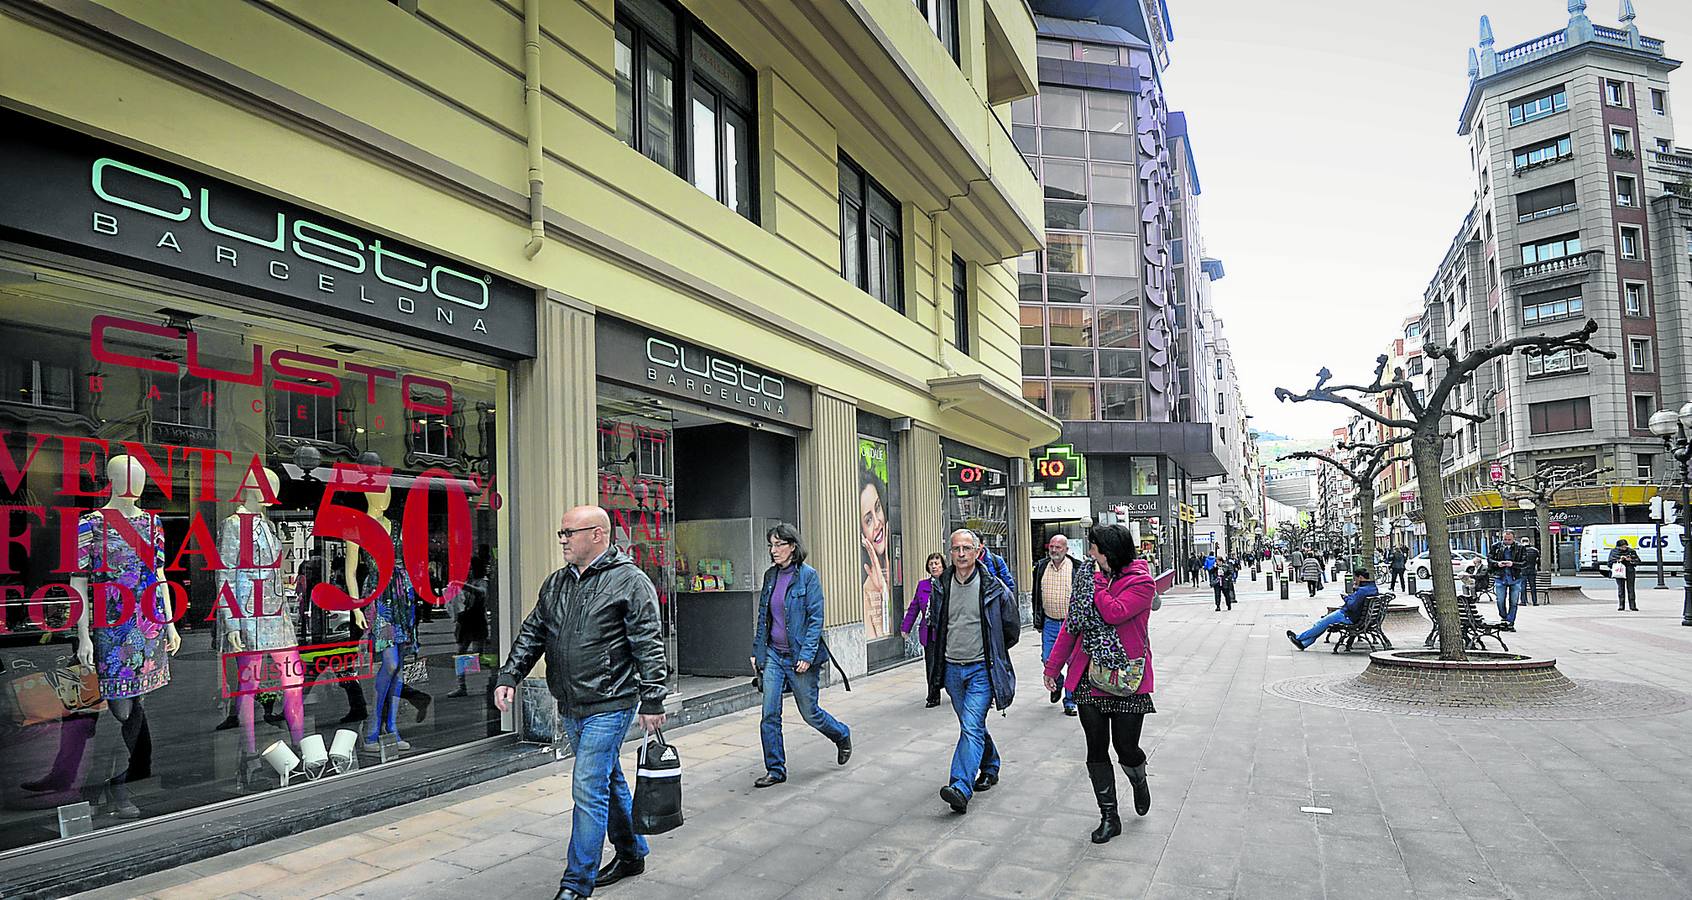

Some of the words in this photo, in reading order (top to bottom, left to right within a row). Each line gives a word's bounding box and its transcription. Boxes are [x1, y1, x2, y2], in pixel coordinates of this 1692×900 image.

[93, 211, 488, 334] BARCELONA
[91, 314, 453, 416] CUSTO
[648, 367, 784, 415] BARCELONA
[89, 375, 454, 440] BARCELONA
[0, 429, 282, 505] VENTA
[1137, 501, 1157, 511] cold
[0, 504, 283, 574] FINAL
[1638, 535, 1669, 548] GLS
[0, 579, 189, 634] TODO
[203, 578, 283, 622] AL
[239, 651, 364, 684] custo.com
